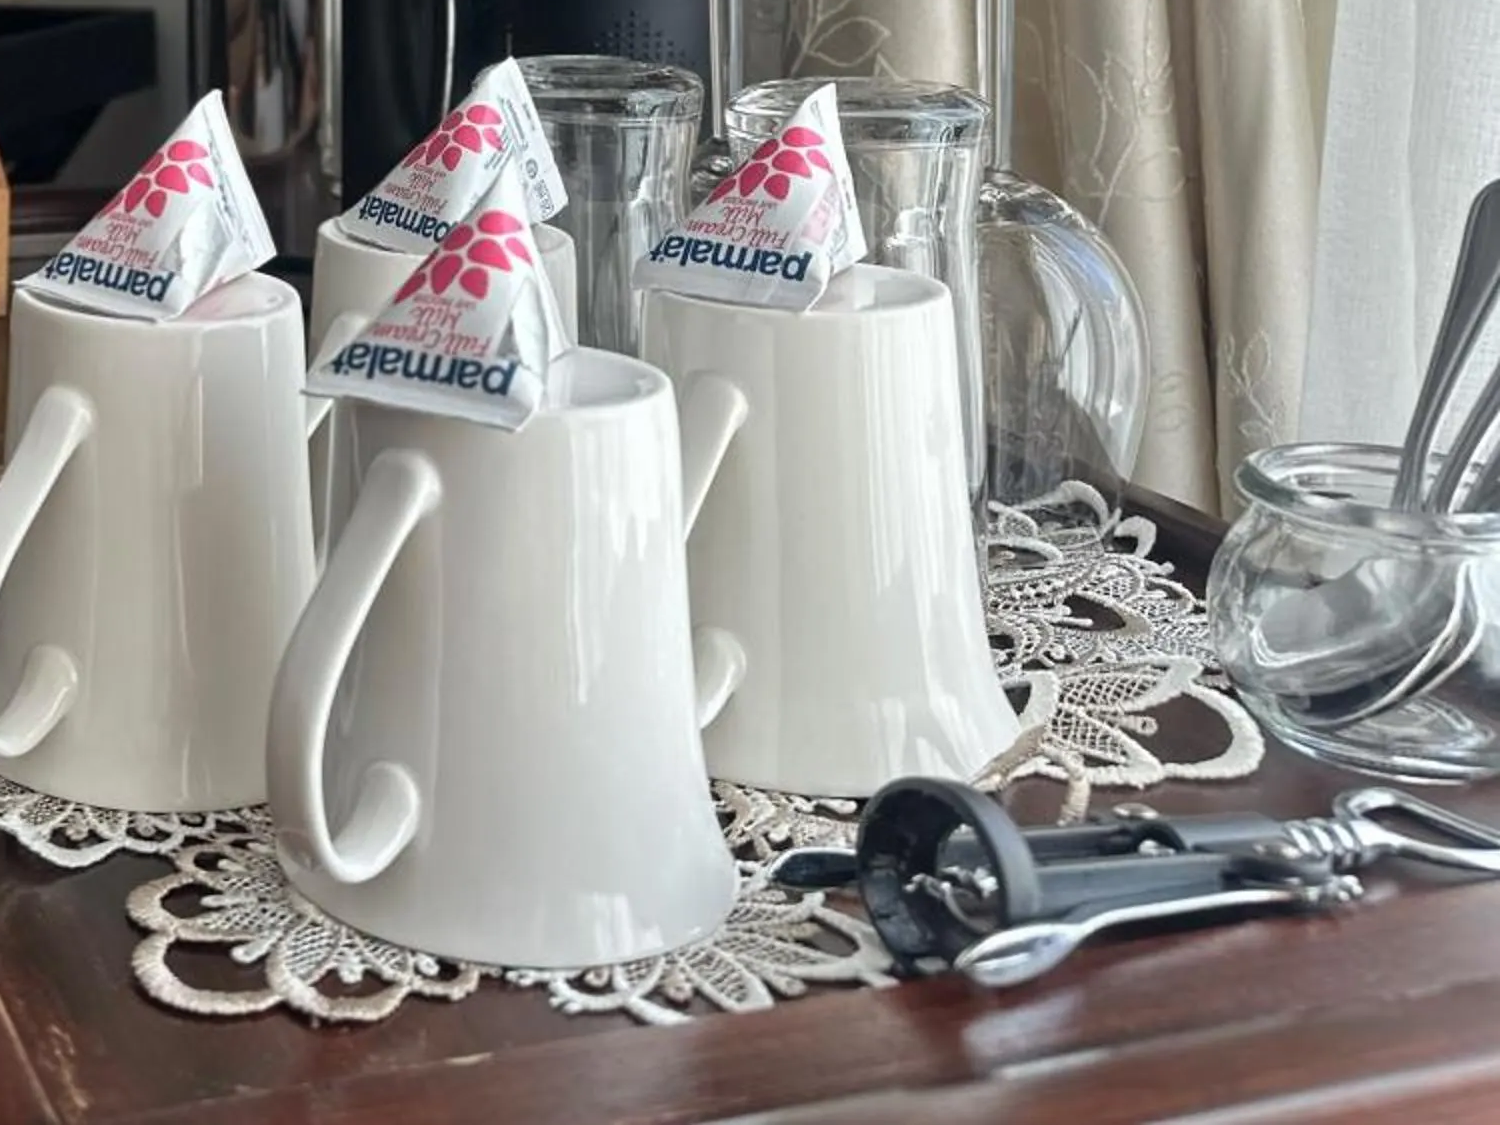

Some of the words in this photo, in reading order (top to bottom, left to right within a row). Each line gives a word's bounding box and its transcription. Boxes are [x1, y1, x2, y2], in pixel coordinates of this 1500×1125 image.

[359, 195, 456, 243] parmalat
[722, 206, 765, 225] Milk
[108, 223, 141, 244] Milk
[686, 219, 747, 242] Cream
[749, 228, 790, 250] Full
[126, 246, 158, 270] Full
[650, 235, 813, 282] parmalat
[46, 252, 175, 302] parmalat
[410, 306, 463, 330] Milk
[370, 321, 443, 349] Cream
[449, 330, 492, 357] Full
[331, 341, 518, 396] parmalat
